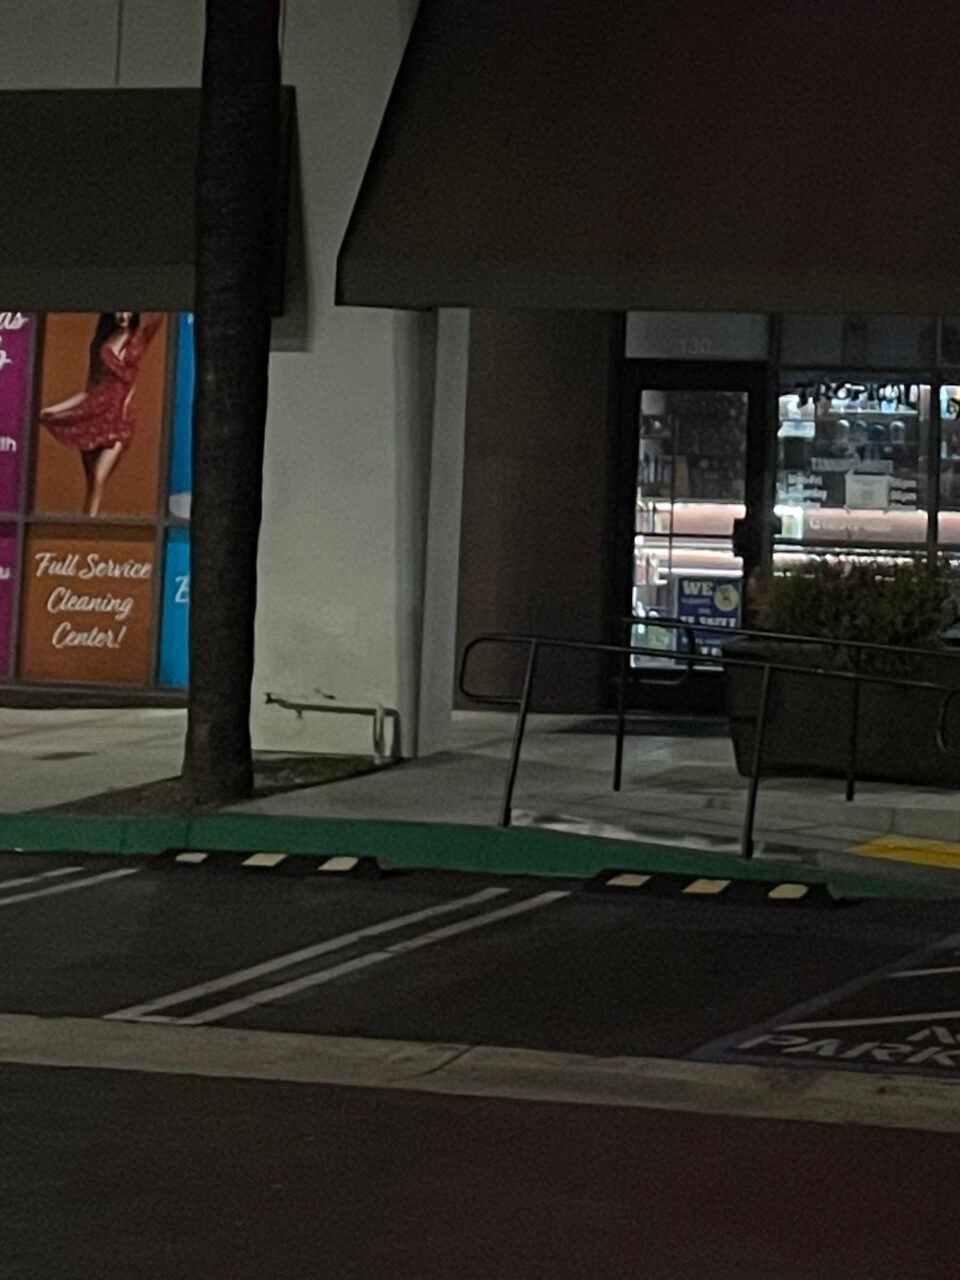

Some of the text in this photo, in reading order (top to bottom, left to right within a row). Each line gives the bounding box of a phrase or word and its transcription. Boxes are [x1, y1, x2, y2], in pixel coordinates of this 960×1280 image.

[35, 551, 77, 578] Full
[79, 553, 152, 579] Service
[682, 579, 714, 597] WE
[46, 586, 134, 621] Cleaning
[52, 624, 128, 650] Center!
